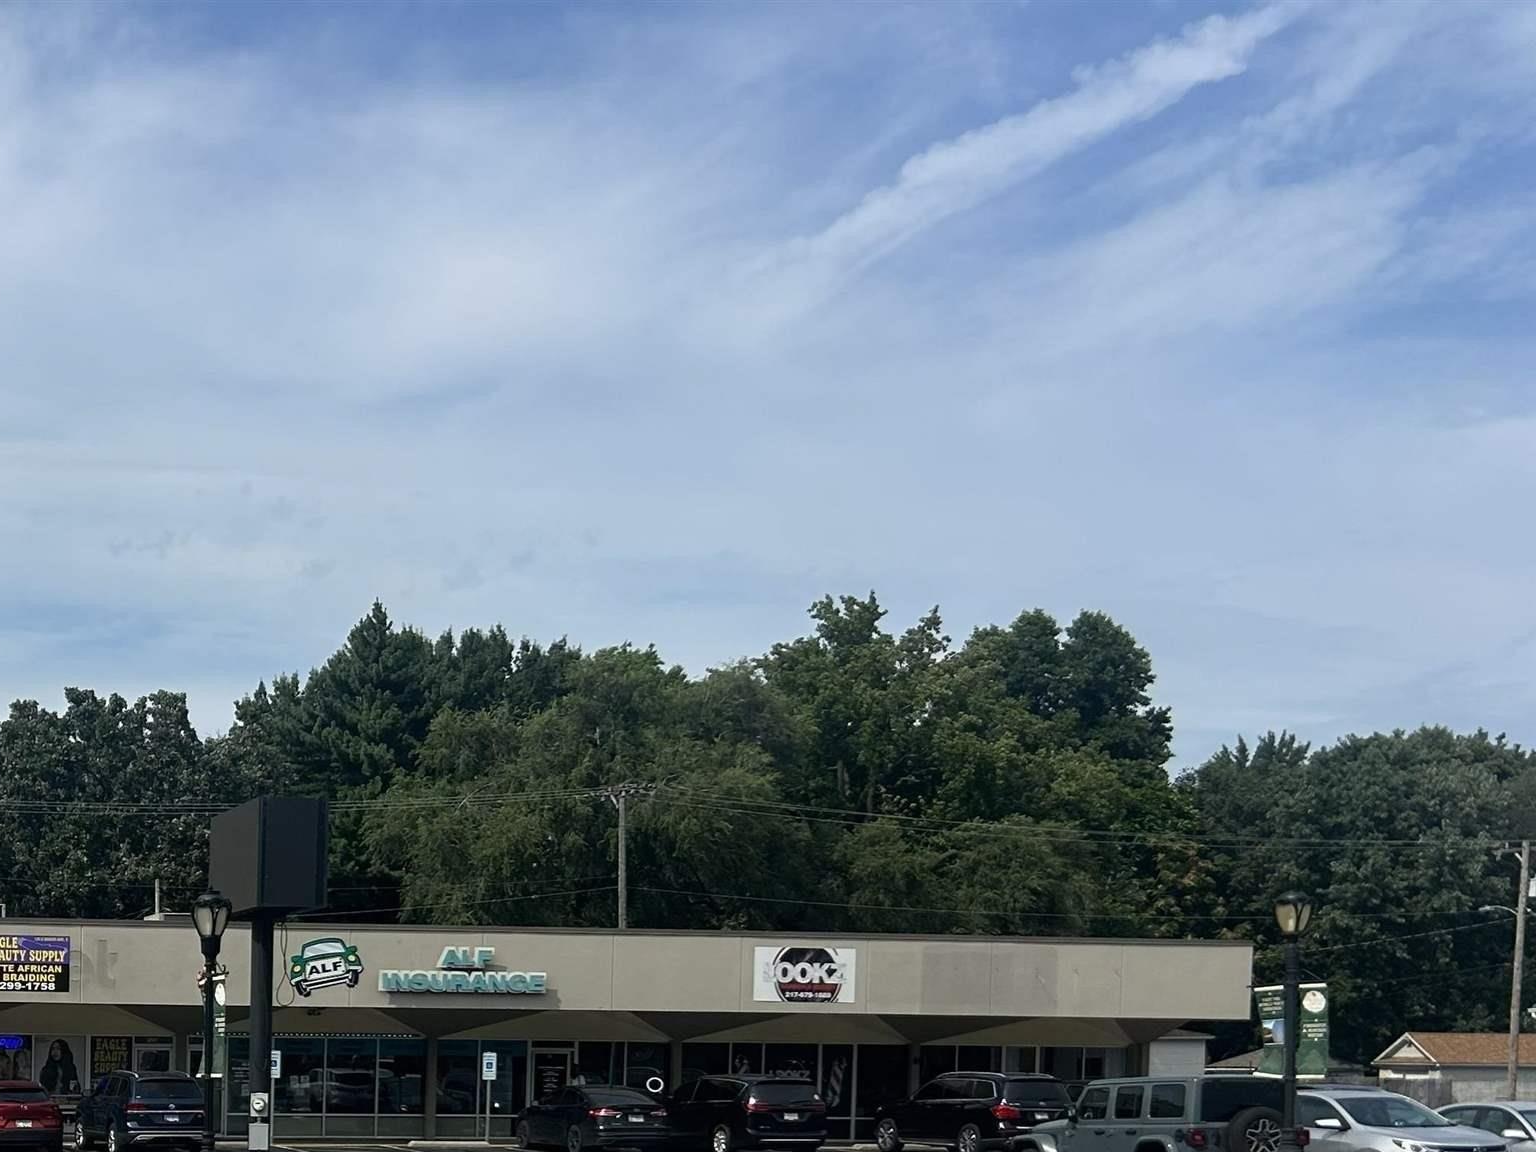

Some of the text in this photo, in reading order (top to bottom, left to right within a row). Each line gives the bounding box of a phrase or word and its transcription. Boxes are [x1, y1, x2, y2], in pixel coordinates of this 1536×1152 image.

[29, 950, 65, 963] SUPPLY
[437, 946, 495, 968] ALF
[17, 965, 62, 973] AFRICAN
[308, 960, 343, 976] ALF
[3, 973, 55, 982] BRAIDING
[378, 970, 546, 993] INSURANCE
[96, 1038, 127, 1050] EAGLE
[94, 1051, 129, 1062] BEAUTY
